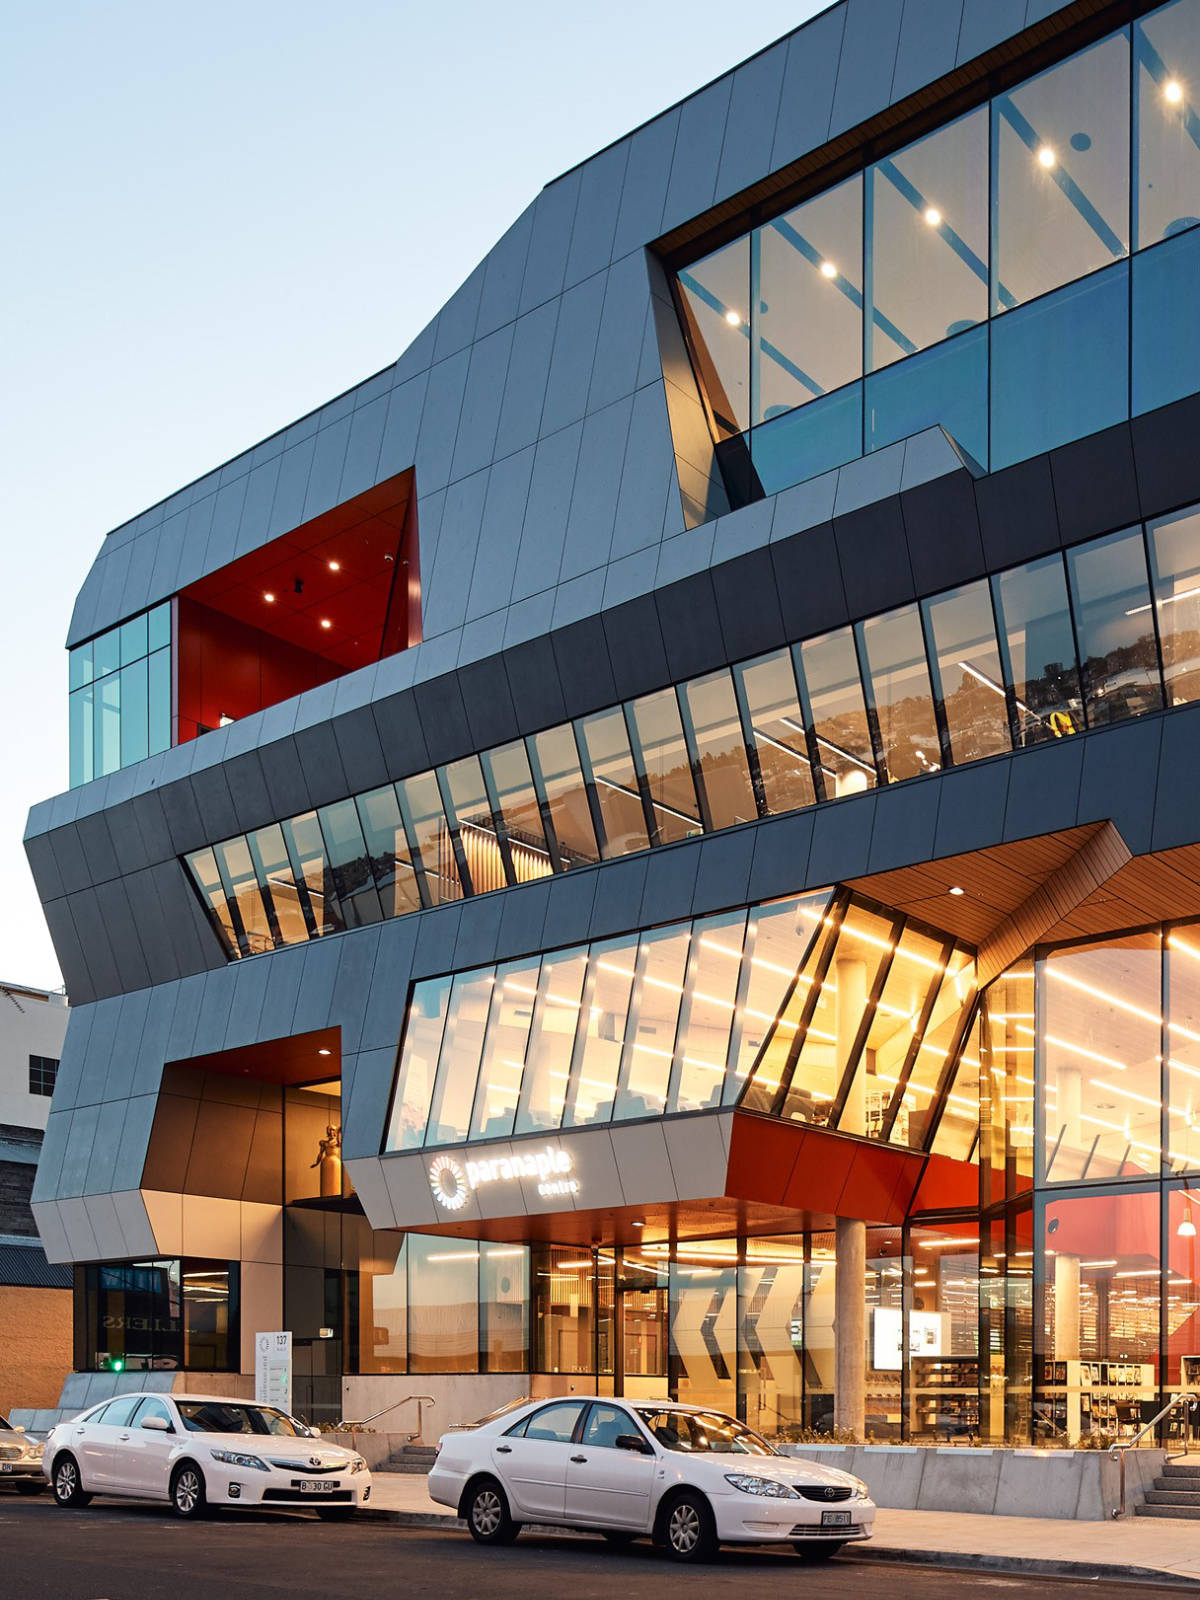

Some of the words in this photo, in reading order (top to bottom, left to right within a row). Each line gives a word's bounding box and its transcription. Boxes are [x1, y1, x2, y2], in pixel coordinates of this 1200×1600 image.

[465, 1146, 572, 1189] paranaple
[537, 1180, 578, 1196] centre
[276, 1335, 287, 1345] 137
